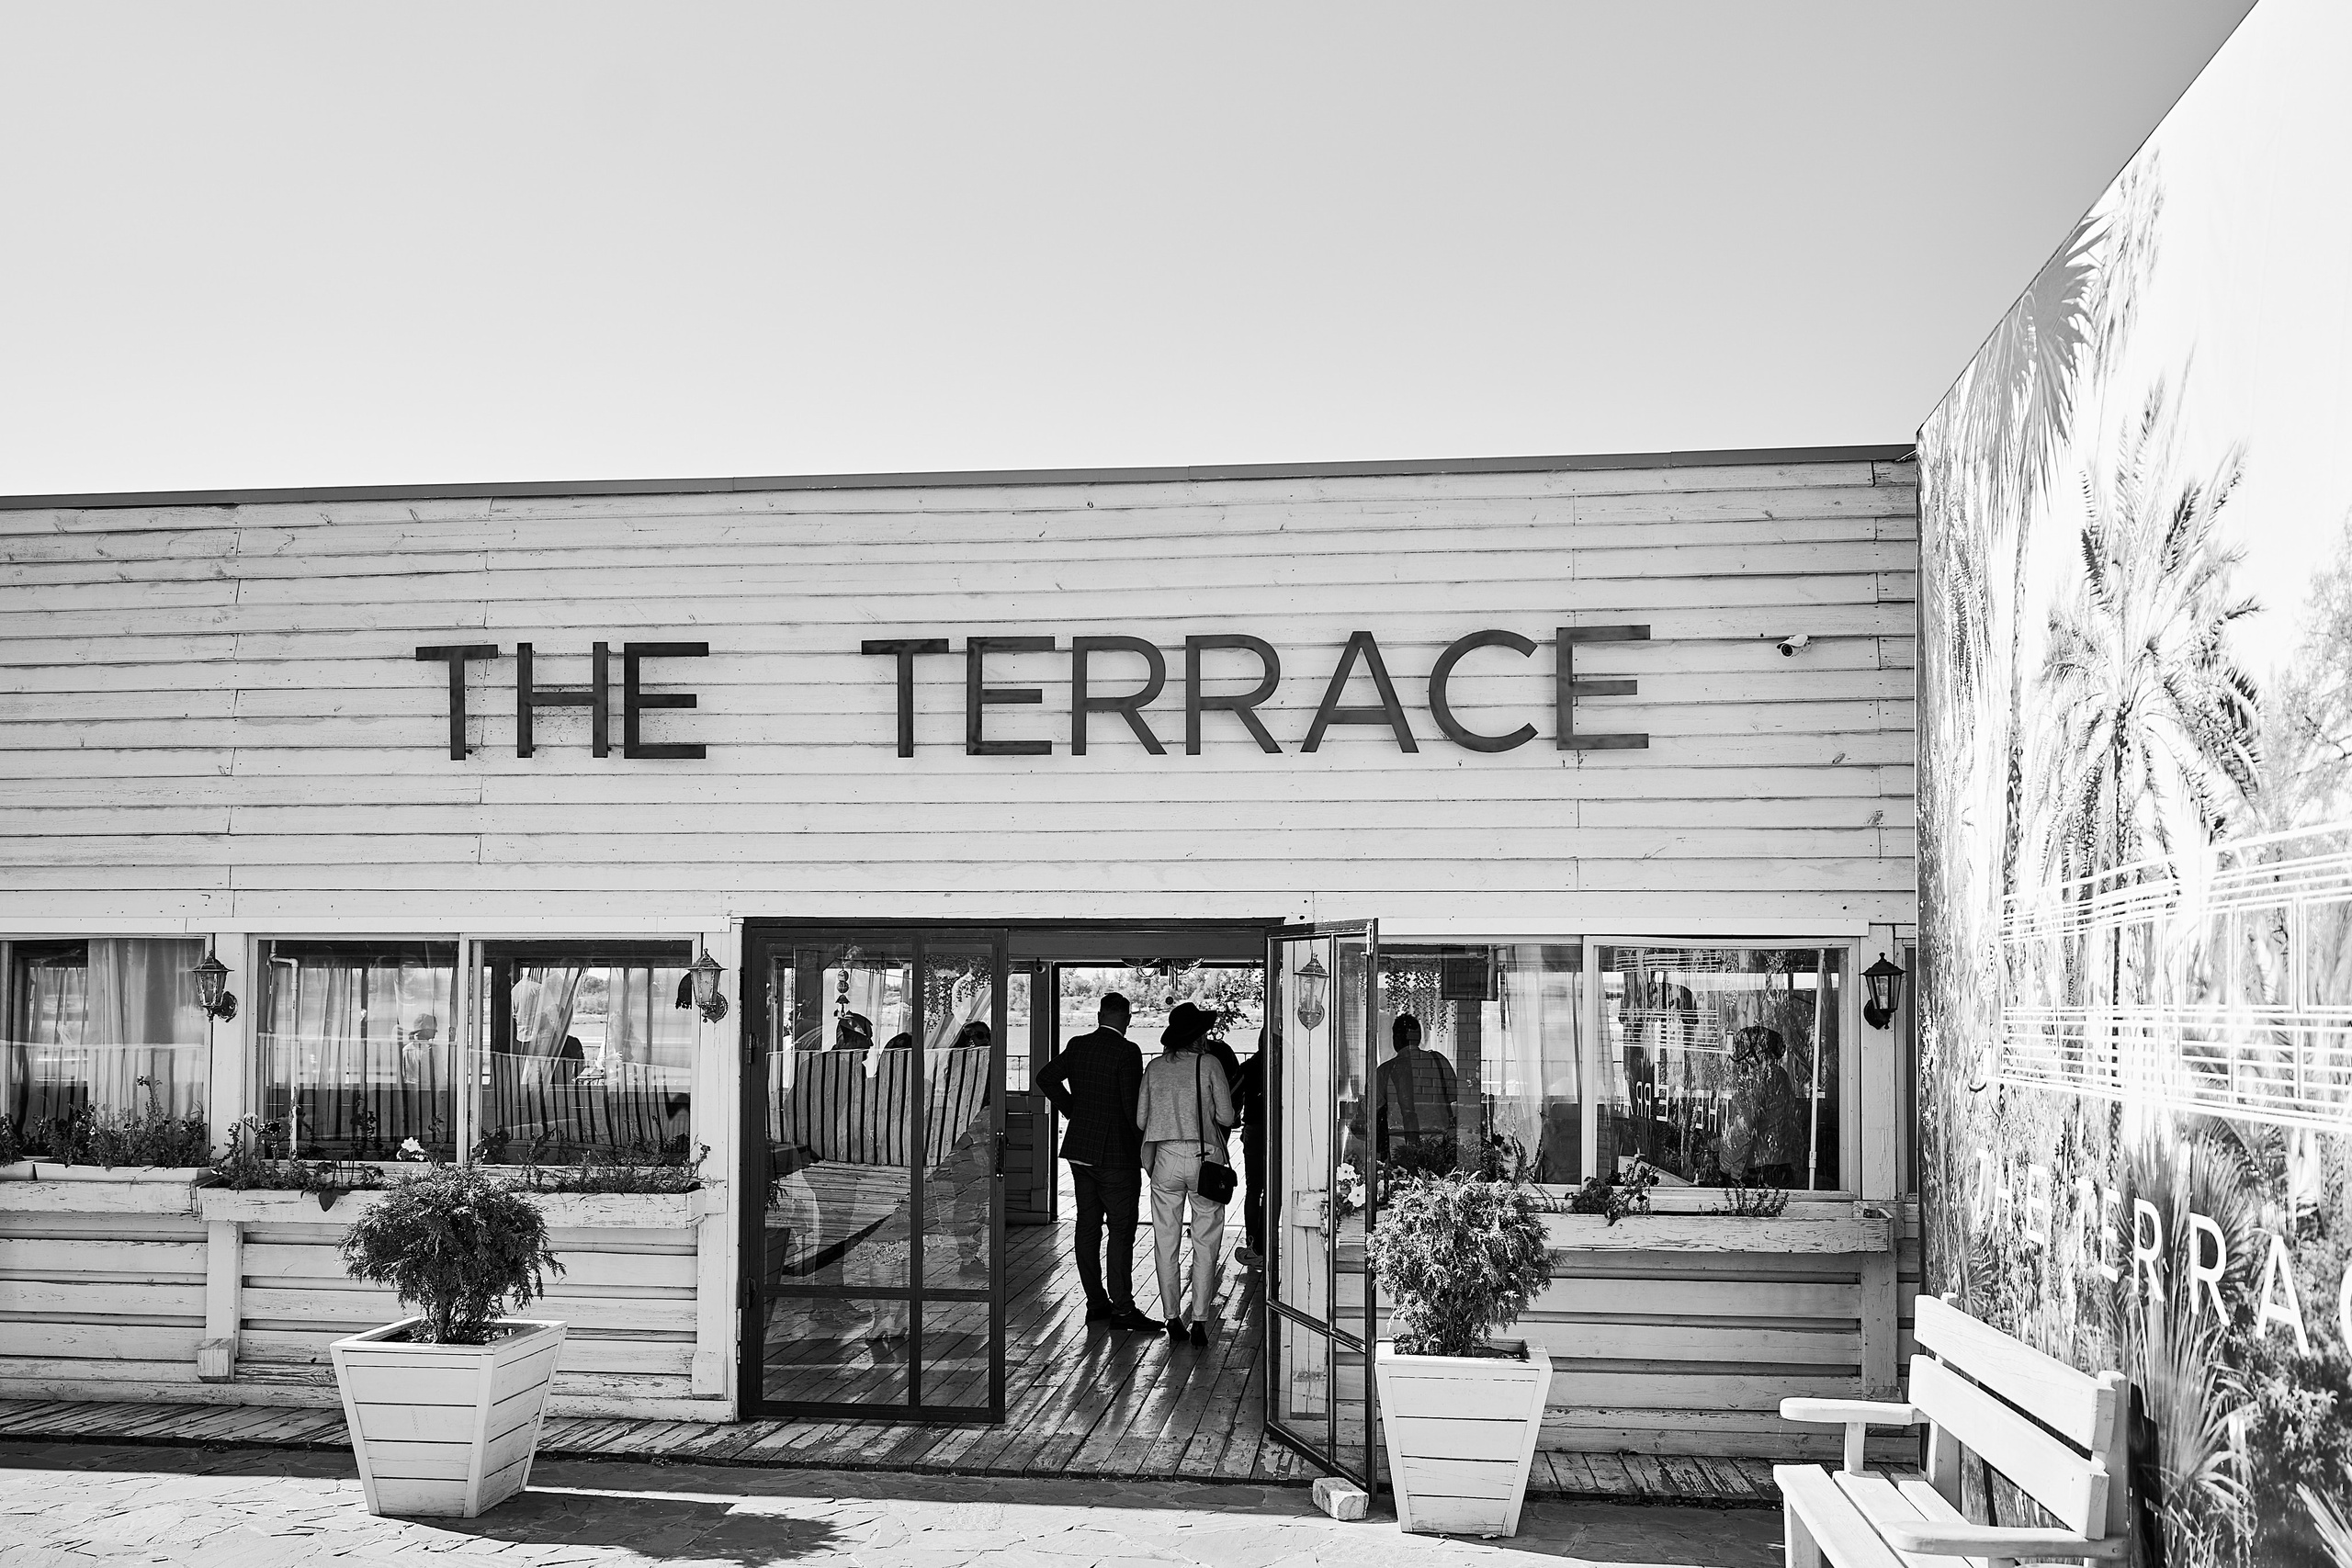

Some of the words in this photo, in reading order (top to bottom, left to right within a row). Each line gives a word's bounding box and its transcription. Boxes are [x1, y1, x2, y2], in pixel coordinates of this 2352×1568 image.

[416, 641, 709, 761] THE
[860, 625, 1652, 759] TERRACE
[1975, 1147, 2049, 1246] THE
[2075, 1176, 2352, 1360] TERRA
